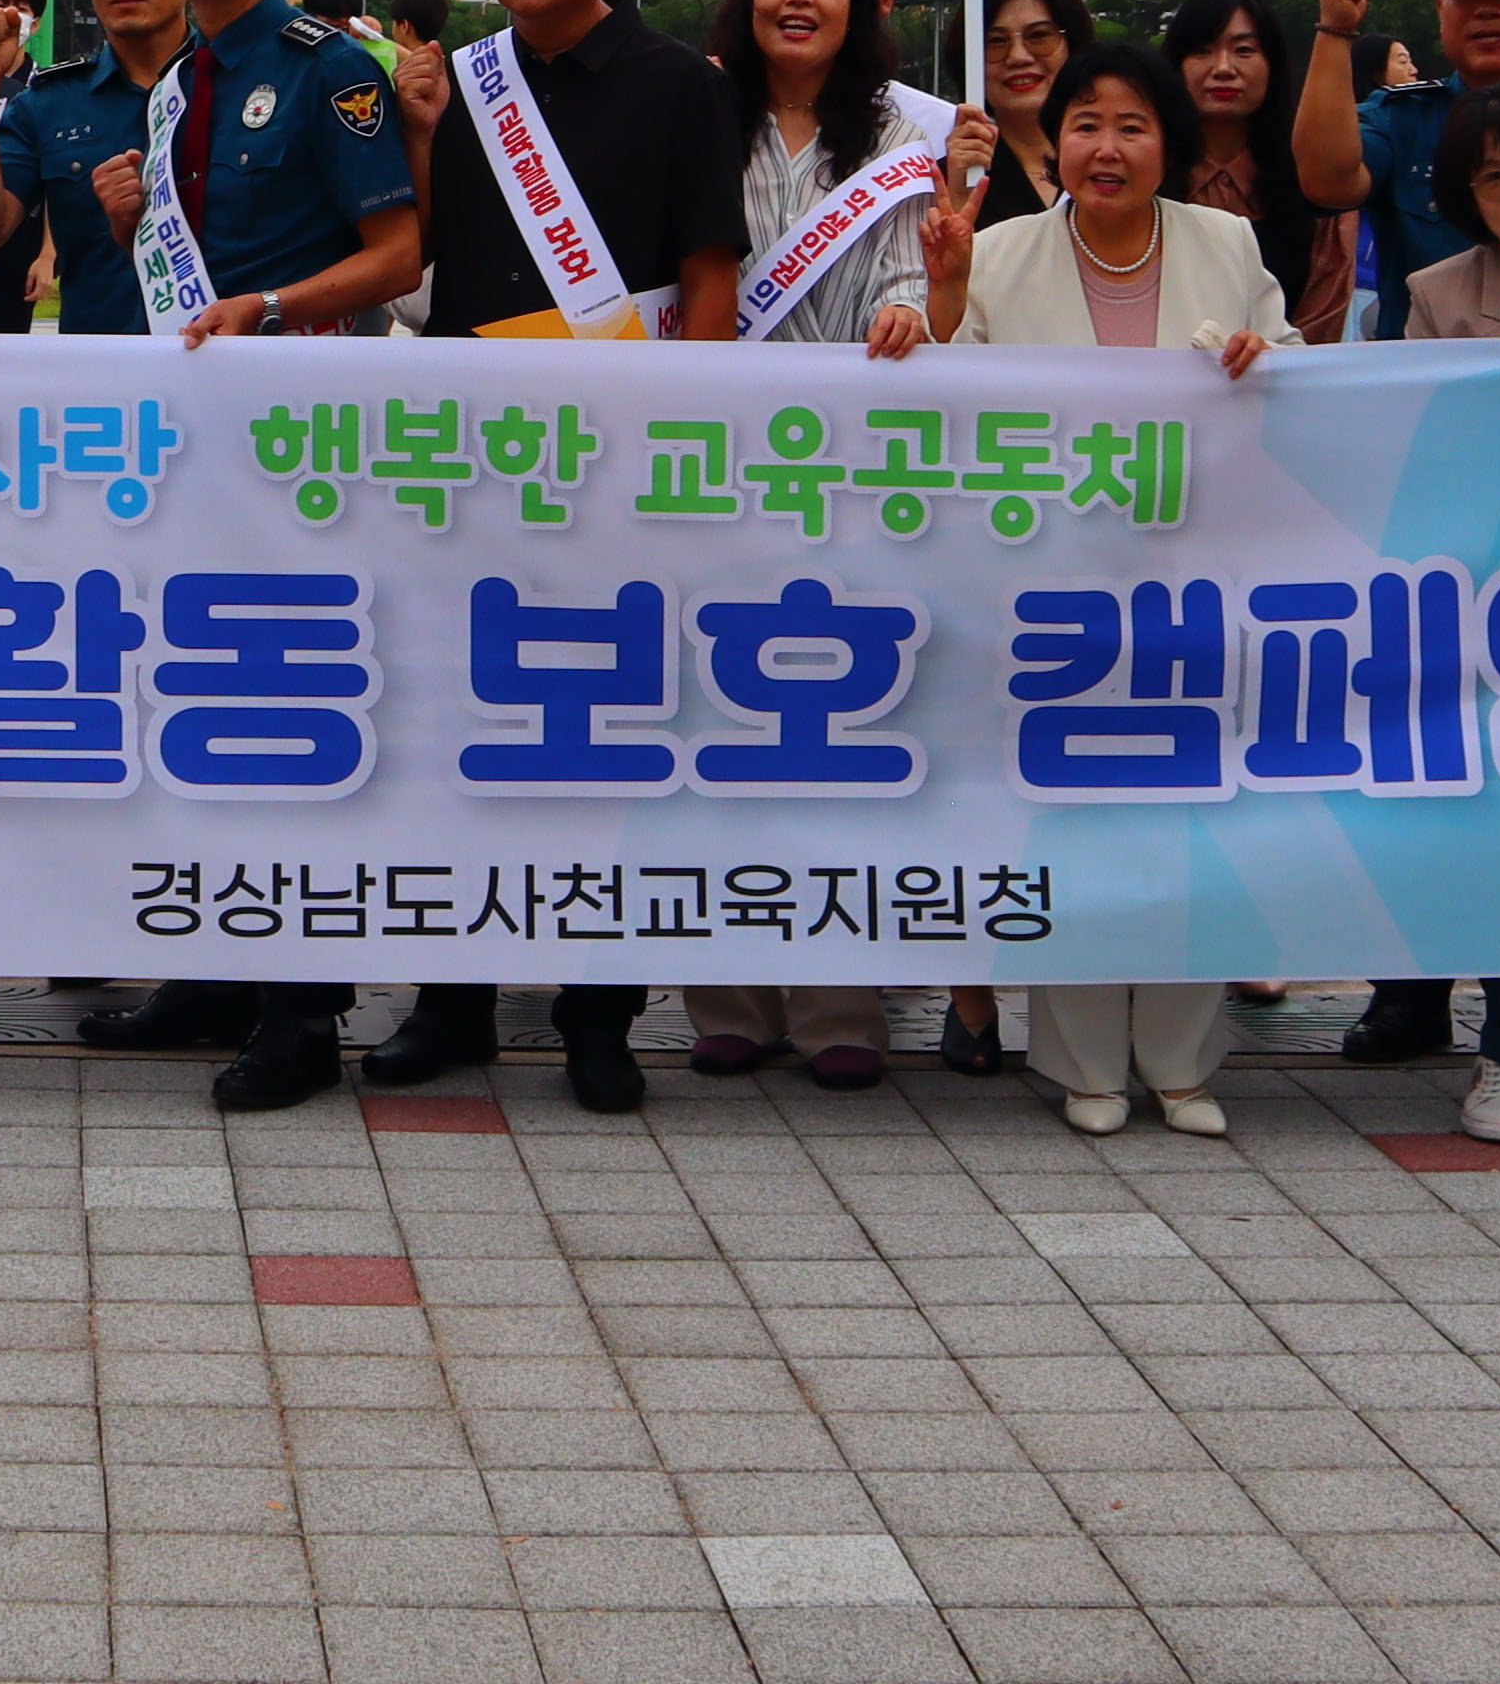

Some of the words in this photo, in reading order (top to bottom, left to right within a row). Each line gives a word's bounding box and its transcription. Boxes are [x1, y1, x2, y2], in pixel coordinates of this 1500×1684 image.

[492, 101, 562, 217] 교육활동
[544, 217, 598, 285] 보호
[871, 154, 936, 192] 권과
[143, 248, 174, 314] 세상
[157, 215, 207, 322] 만들어
[747, 188, 877, 314] 학생인권의
[250, 398, 597, 528] 행복한
[635, 405, 1185, 538] 교육공동체
[458, 576, 916, 784] 보호
[132, 862, 1052, 942] 경상남도사천교육지원청
